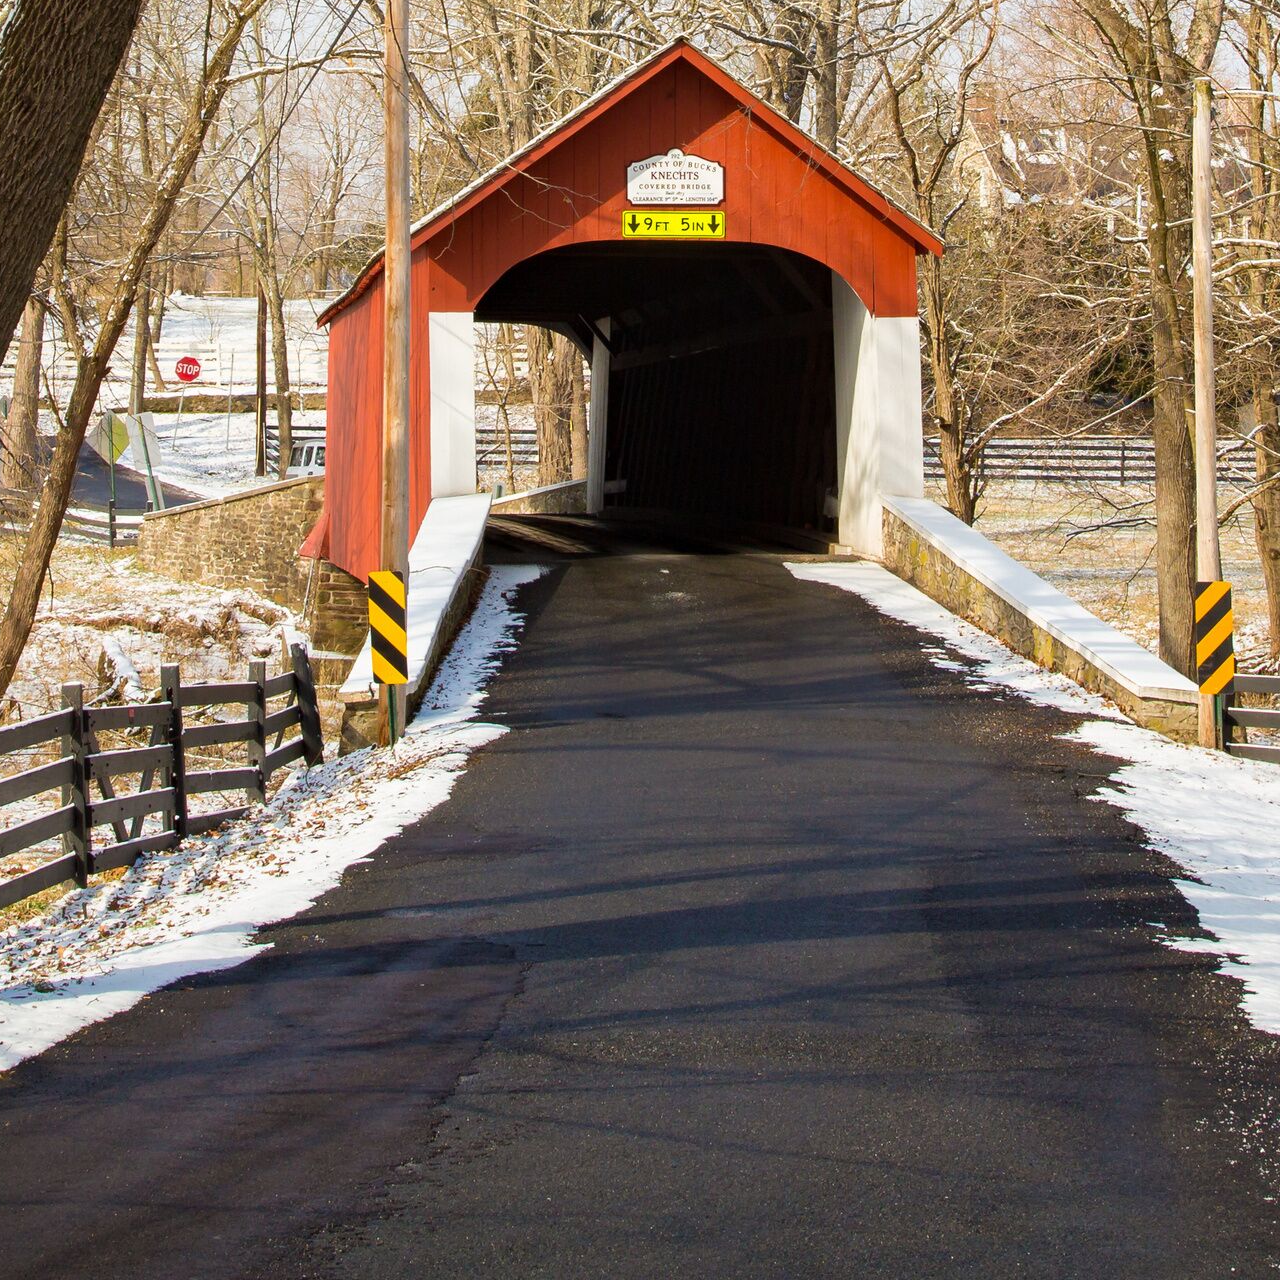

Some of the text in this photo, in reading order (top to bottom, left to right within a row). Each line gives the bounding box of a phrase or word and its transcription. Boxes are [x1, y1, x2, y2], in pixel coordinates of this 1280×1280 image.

[632, 161, 669, 172] COUNTY
[688, 161, 717, 172] BUCKS
[651, 171, 699, 180] KNECHTS
[177, 363, 200, 375] STOP
